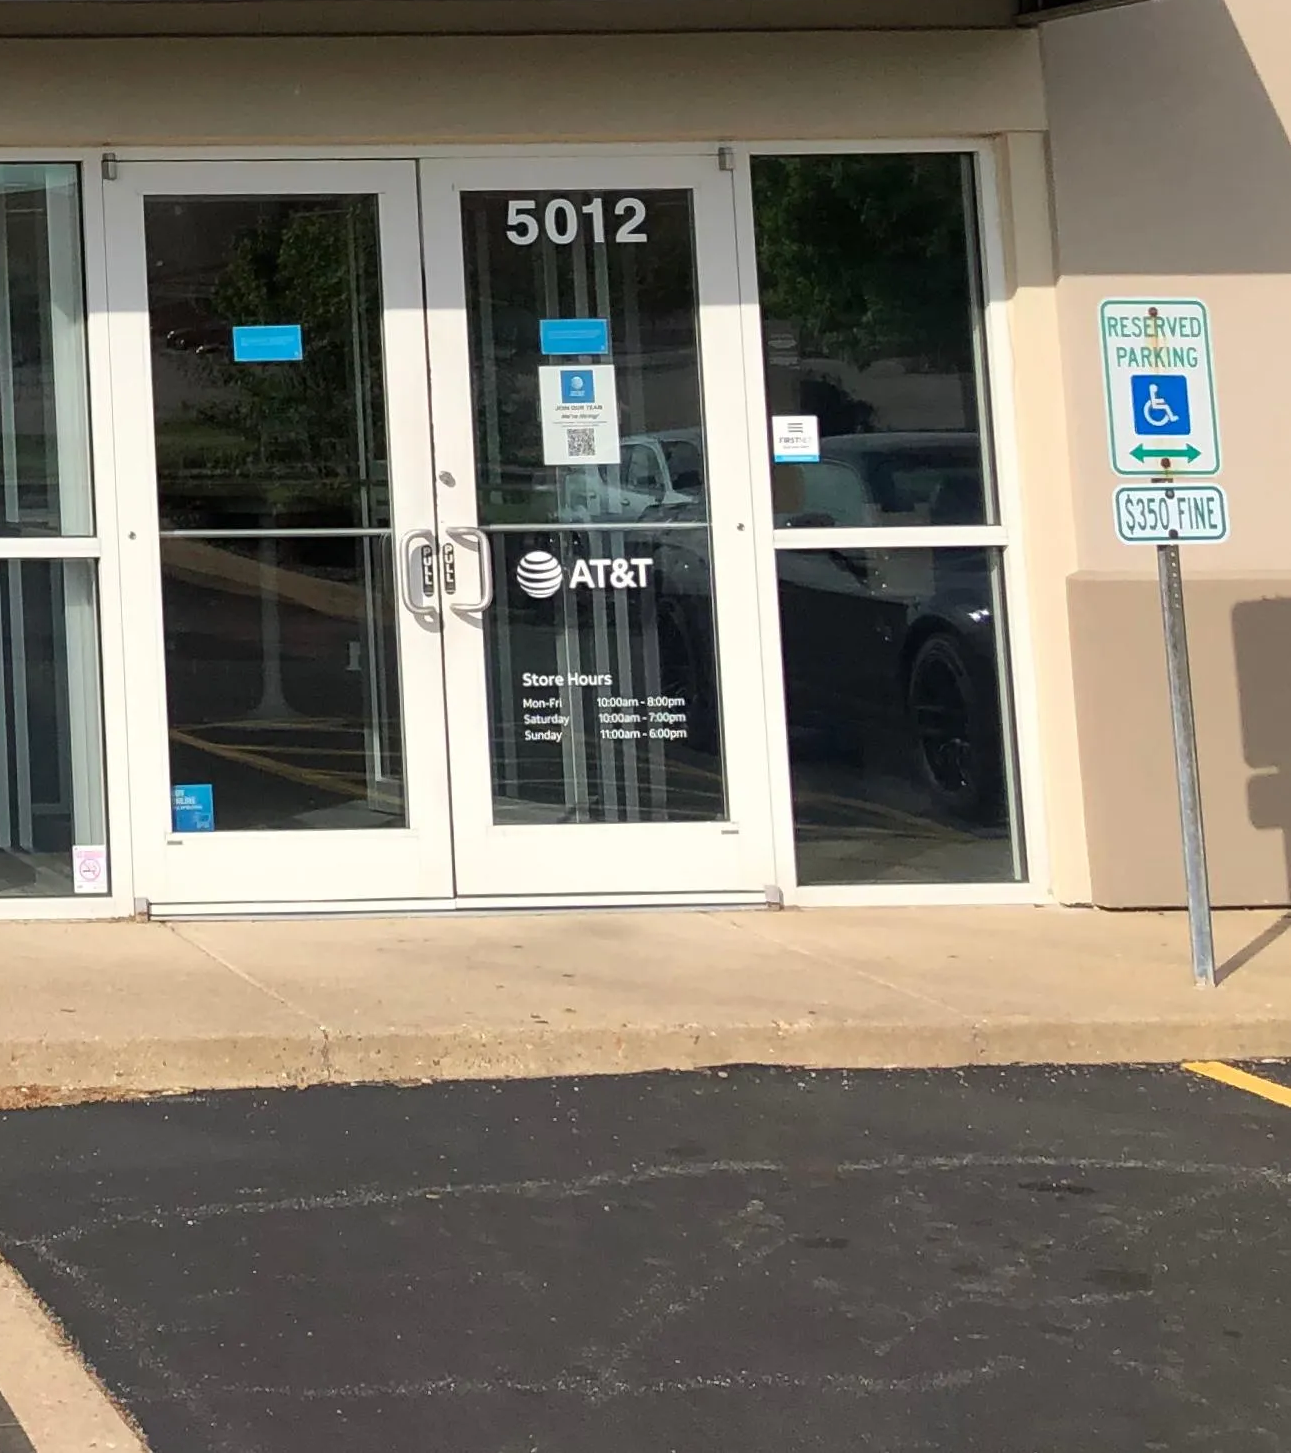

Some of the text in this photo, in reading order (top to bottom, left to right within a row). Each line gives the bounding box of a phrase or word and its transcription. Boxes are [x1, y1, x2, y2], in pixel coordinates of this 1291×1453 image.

[506, 197, 648, 245] 5012
[1107, 316, 1202, 338] RESERVED
[1116, 346, 1198, 368] PARKING
[1125, 495, 1218, 534] $350 FINE
[422, 547, 433, 585] PULL
[443, 544, 454, 583] PULL
[569, 557, 654, 589] AT&T
[522, 672, 613, 686] Store Hours
[522, 698, 563, 708] Mon-Fri
[646, 696, 686, 709] 8:00pm
[523, 714, 570, 726] Saturday
[648, 712, 687, 725] 7:00pm
[524, 730, 563, 742] Sunday
[600, 729, 641, 739] 11:00am
[649, 728, 688, 741] 6:00pm
